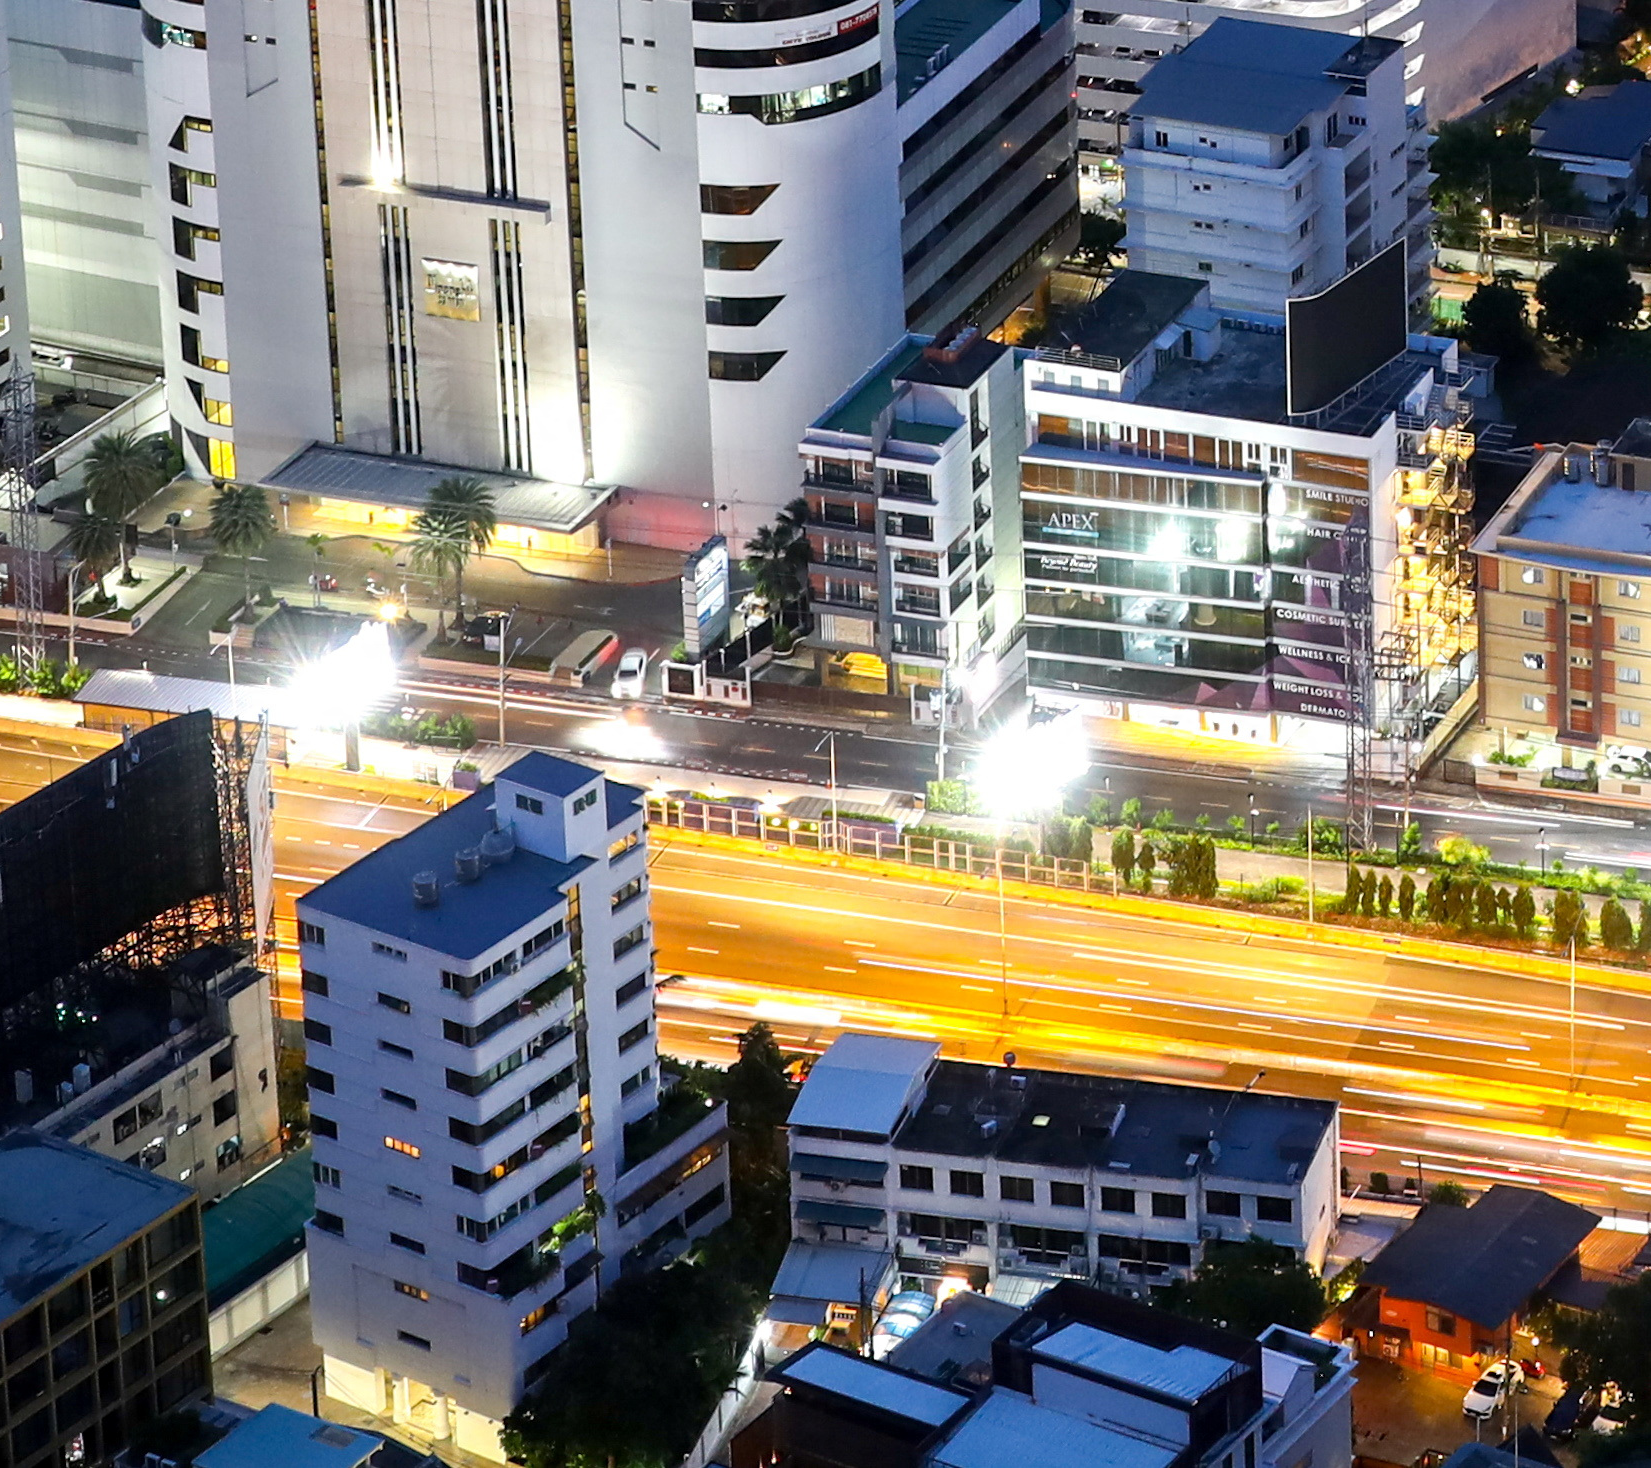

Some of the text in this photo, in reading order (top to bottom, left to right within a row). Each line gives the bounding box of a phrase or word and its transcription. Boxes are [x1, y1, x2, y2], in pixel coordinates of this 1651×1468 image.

[1305, 488, 1369, 507] SMILE STUDIO
[1048, 512, 1094, 531] APEX
[1306, 528, 1331, 540] HAIR
[1291, 574, 1341, 590] AESTHETIC
[1276, 608, 1327, 625] COSMETIC
[1278, 645, 1324, 661] WELLNESS
[1273, 680, 1309, 695] WEIGHT
[1310, 686, 1334, 699] LOSS
